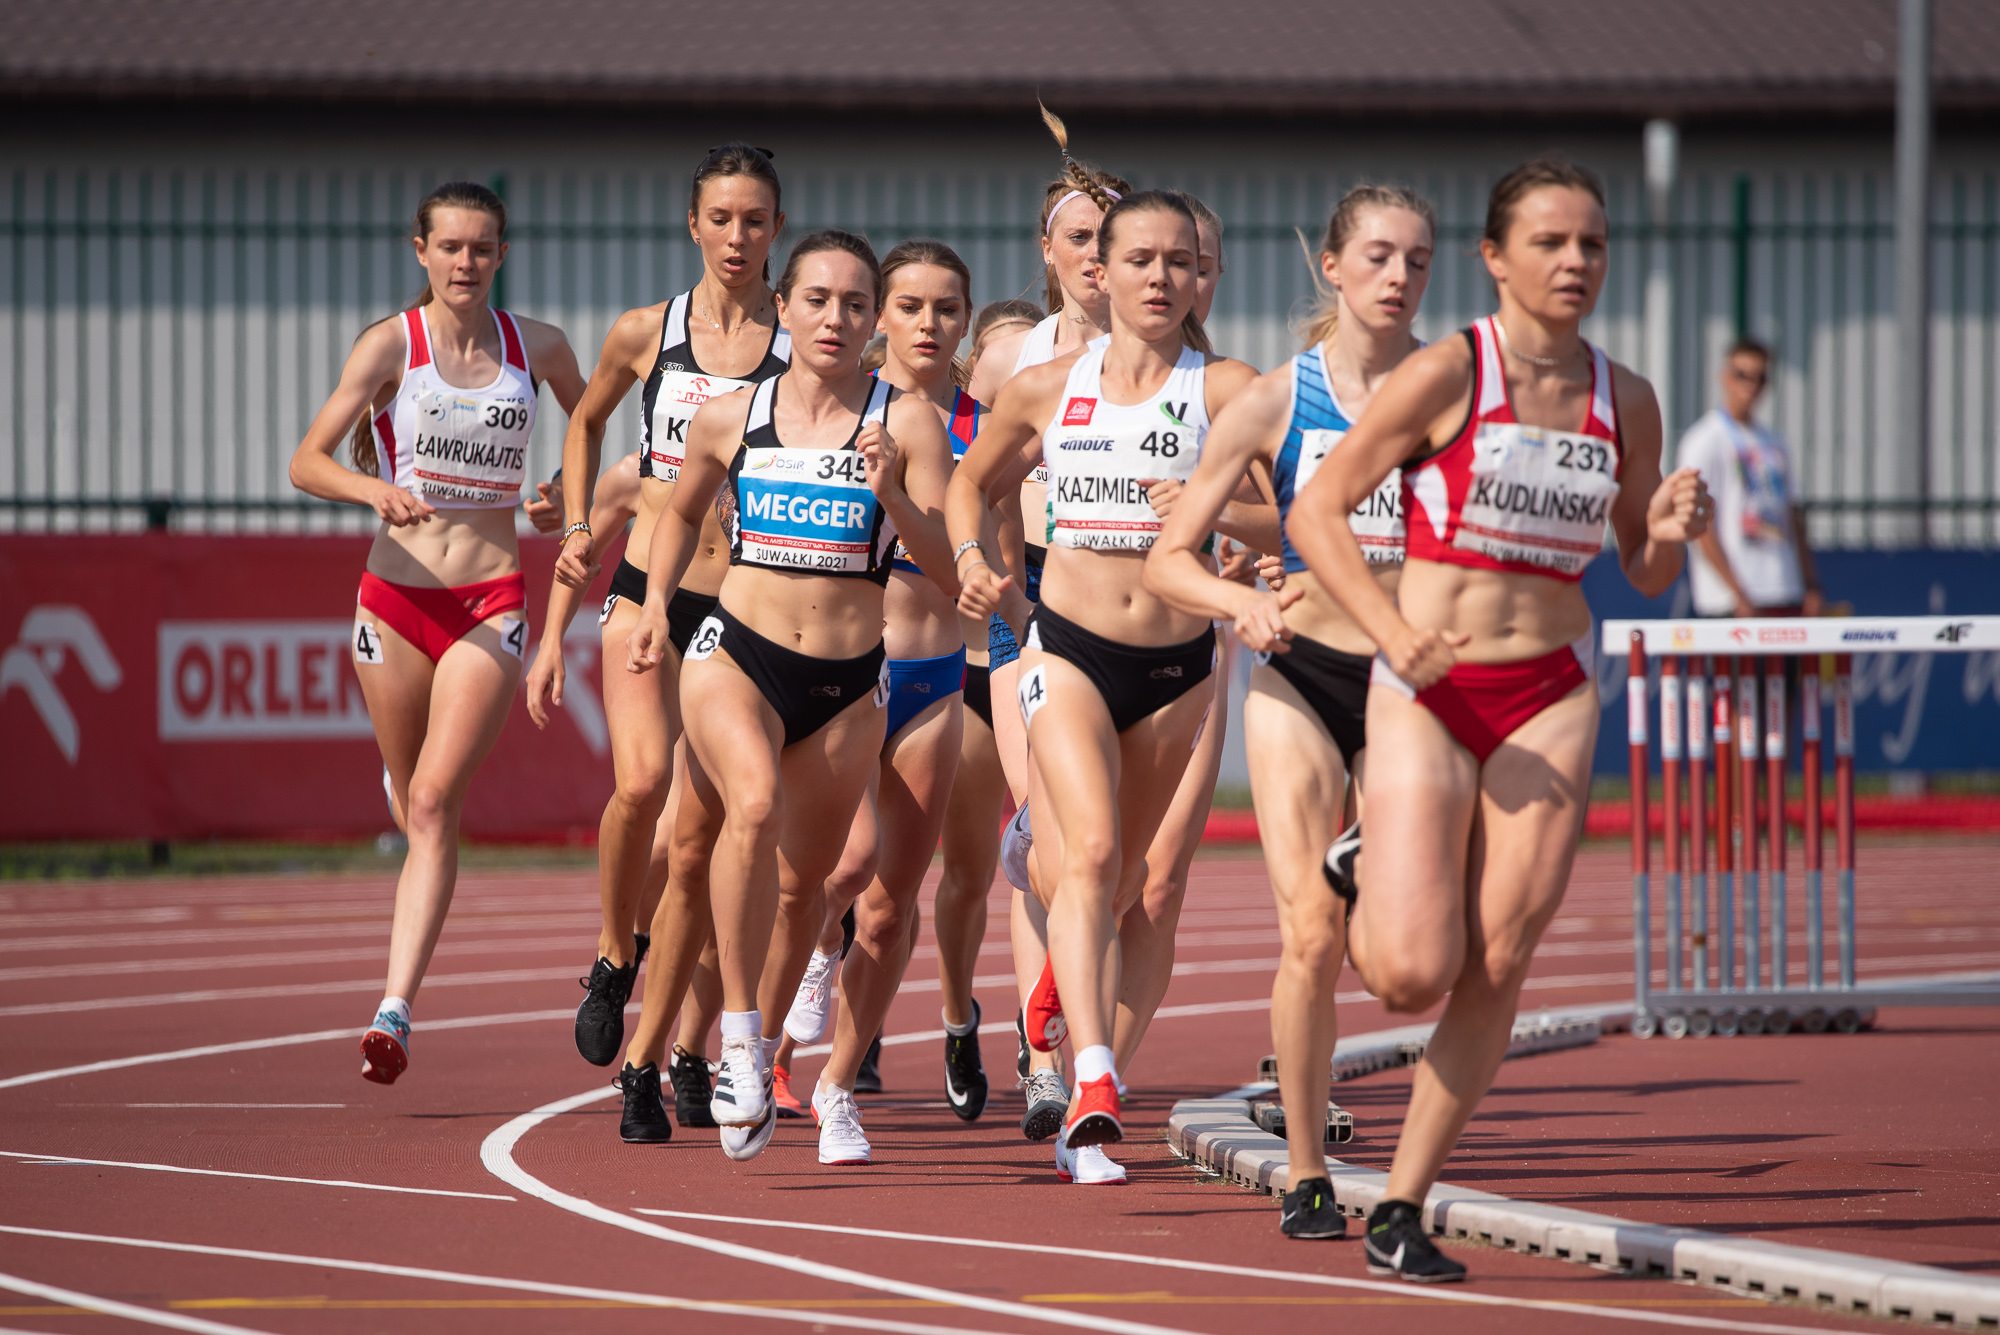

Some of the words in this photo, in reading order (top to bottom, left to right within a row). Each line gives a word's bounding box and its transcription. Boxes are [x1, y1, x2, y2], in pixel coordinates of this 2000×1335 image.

[485, 405, 528, 431] 309
[416, 433, 523, 470] ŁAWRUKAJTIS
[1139, 431, 1179, 458] 48
[1557, 440, 1608, 473] 232
[816, 454, 868, 483] 345
[421, 482, 475, 500] SUWAŁKI
[478, 491, 502, 503] 2021
[1474, 478, 1607, 524] KUDLIŃSKA
[746, 491, 866, 529] MEGGER
[770, 538, 823, 549] MISTRZOSTWA
[1072, 533, 1133, 548] SUWAŁKI
[1137, 535, 1158, 549] 20
[756, 548, 812, 566] SUWAŁKI
[816, 555, 848, 568] 2021
[357, 626, 375, 660] 4
[507, 622, 524, 656] 4
[175, 639, 369, 721] ORLEN
[1020, 673, 1044, 718] 14
